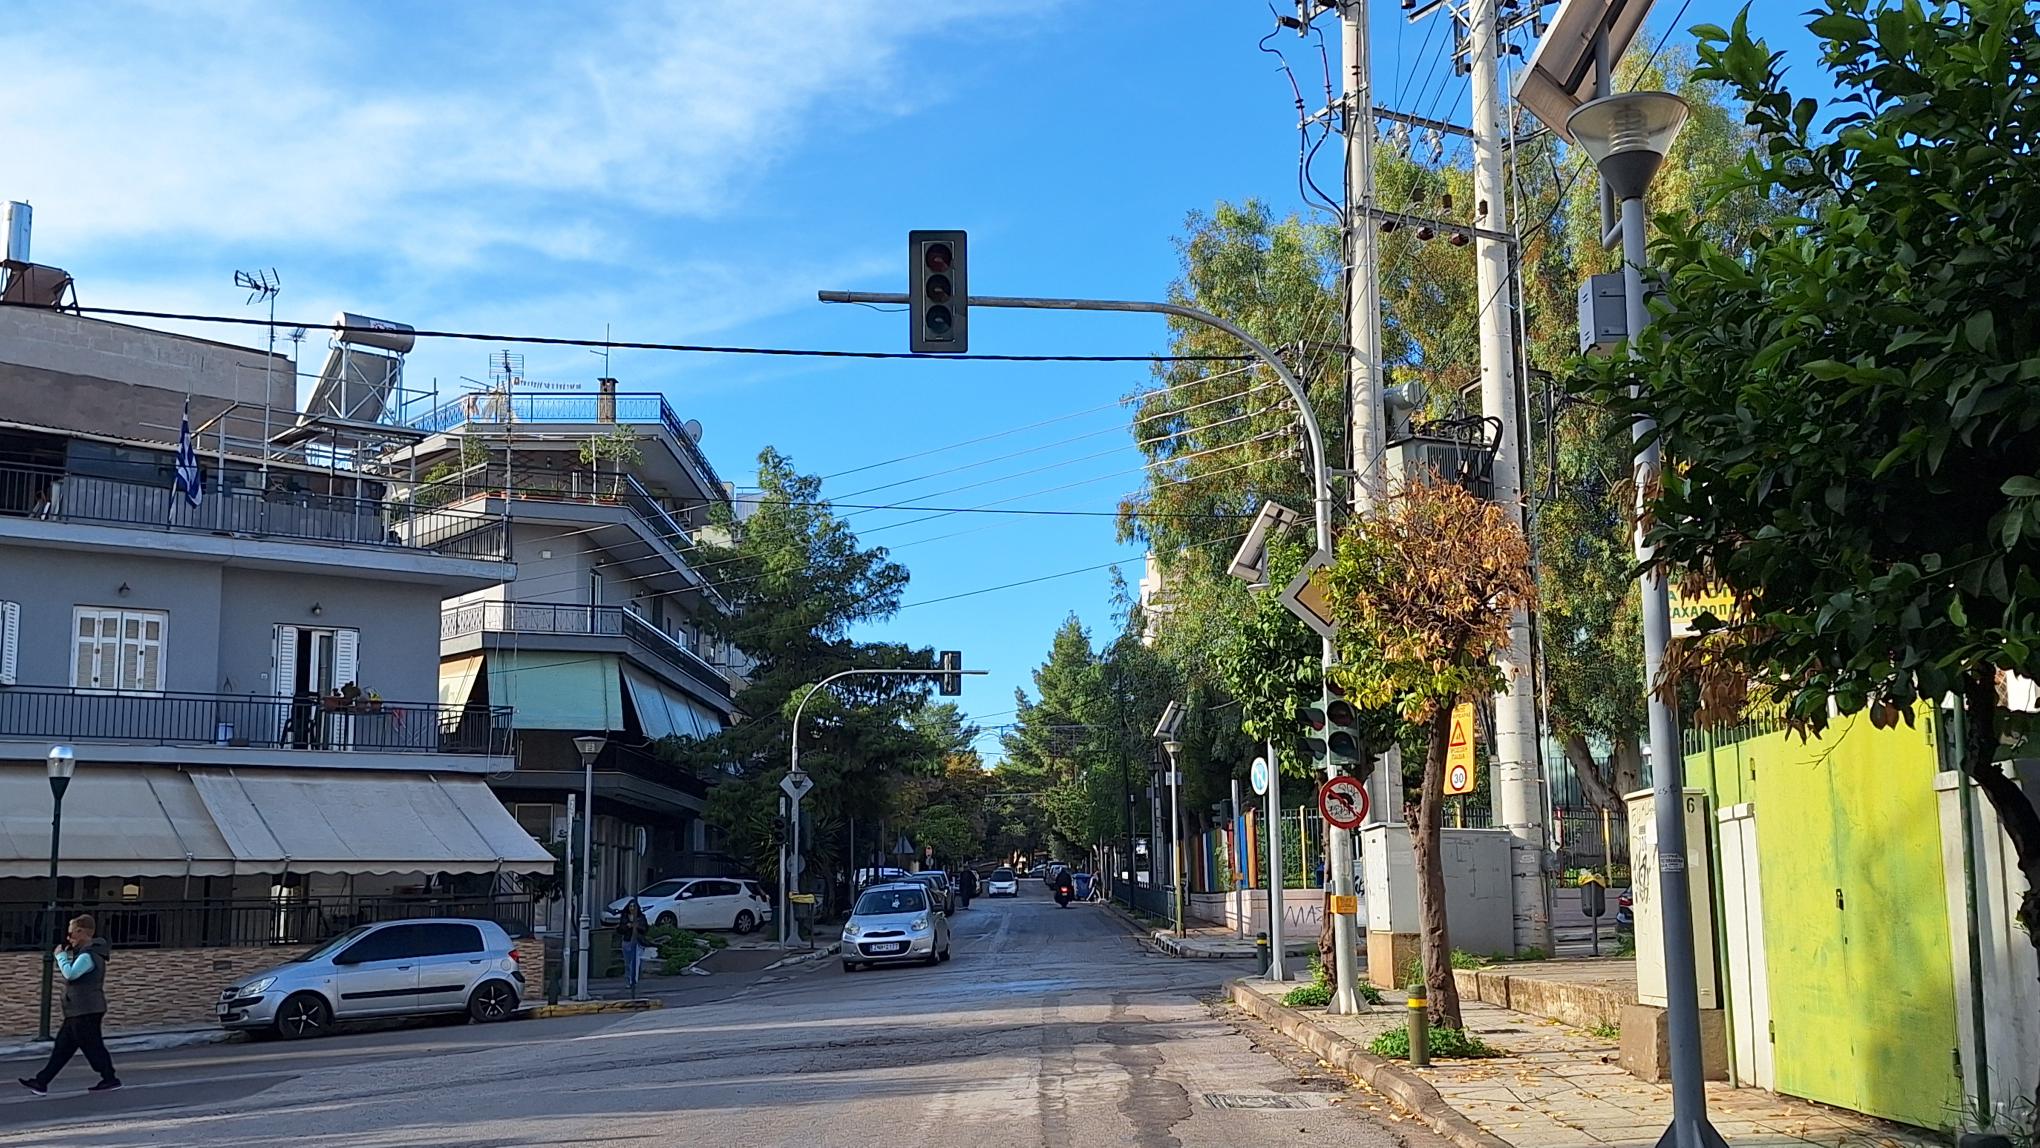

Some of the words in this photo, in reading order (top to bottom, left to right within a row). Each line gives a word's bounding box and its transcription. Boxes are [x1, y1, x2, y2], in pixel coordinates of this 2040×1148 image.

[1670, 604, 1735, 619] ΑΧΑΡΟΠ
[1454, 773, 1464, 784] 30
[1686, 797, 1695, 814] 6
